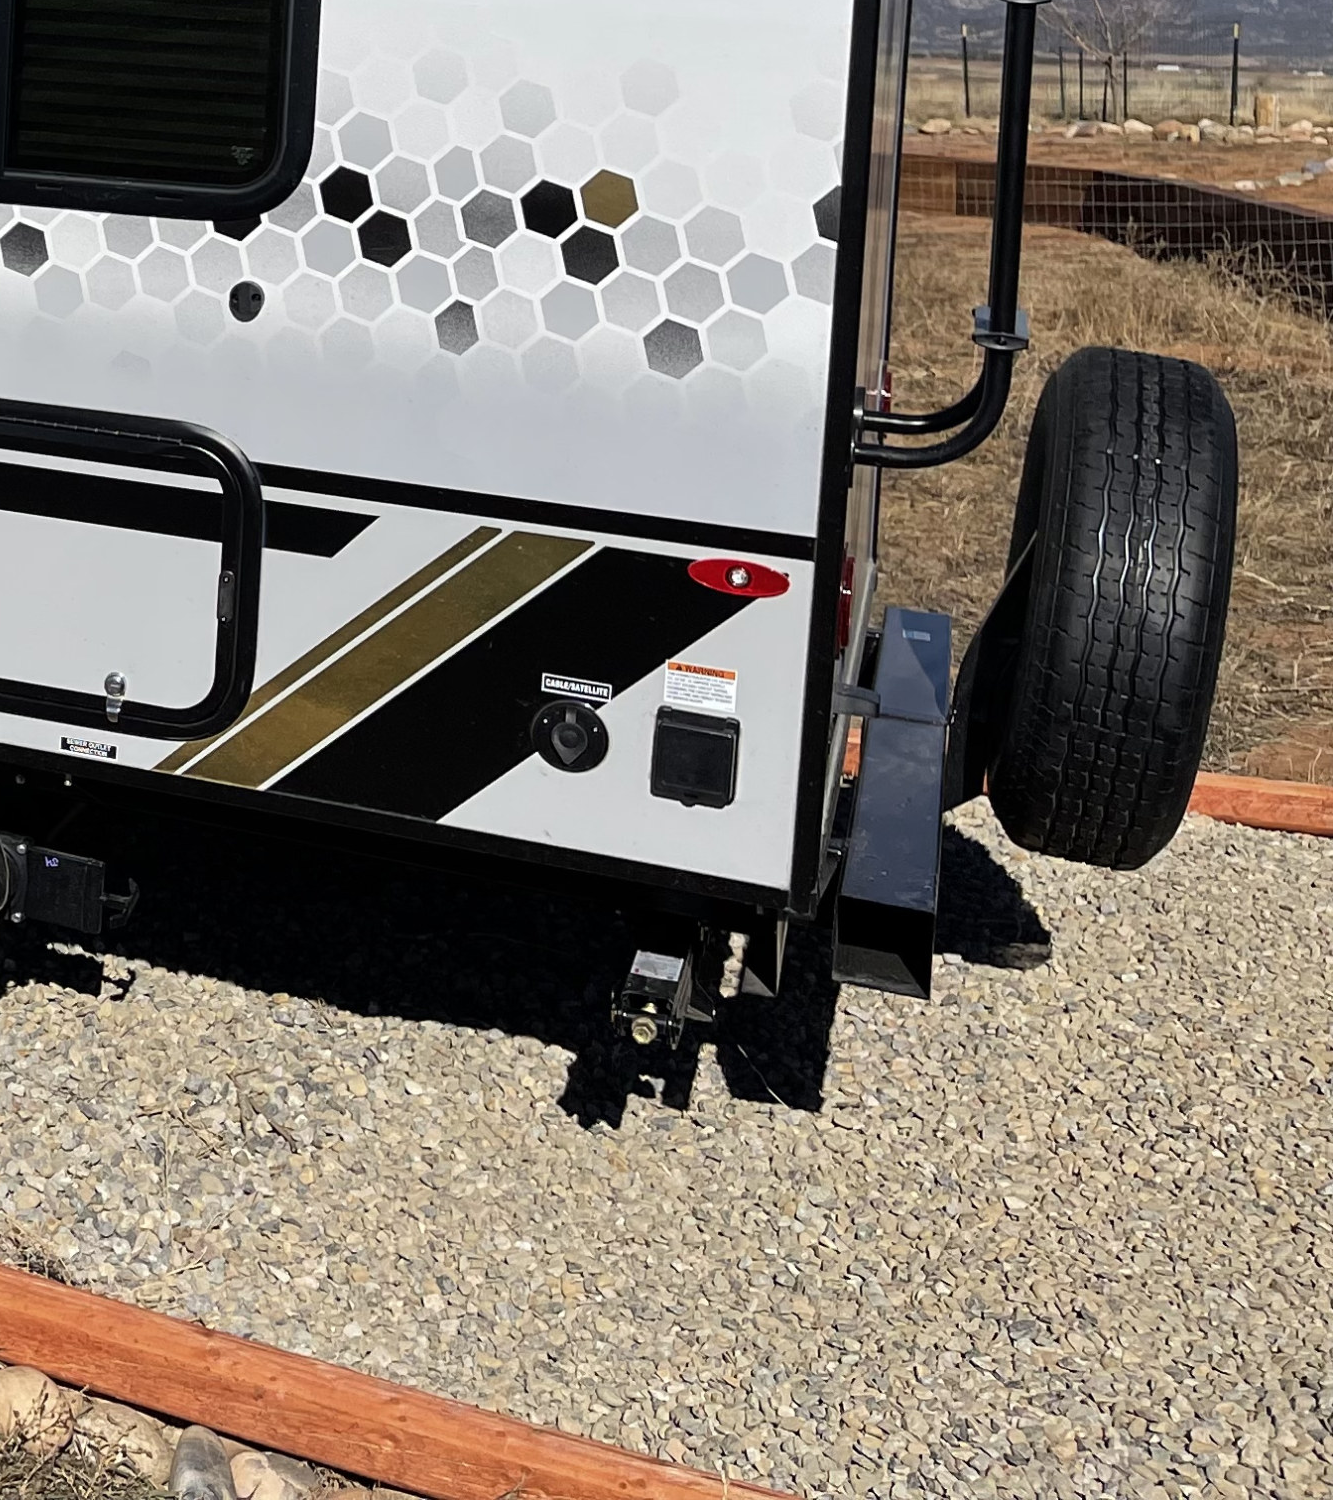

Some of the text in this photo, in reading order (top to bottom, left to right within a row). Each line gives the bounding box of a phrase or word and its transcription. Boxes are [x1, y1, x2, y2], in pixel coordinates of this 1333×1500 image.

[685, 663, 725, 679] WARNING
[545, 678, 609, 697] CABLE/SATELLITE
[69, 745, 108, 757] CONNECTION
[88, 741, 111, 752] OUTLET
